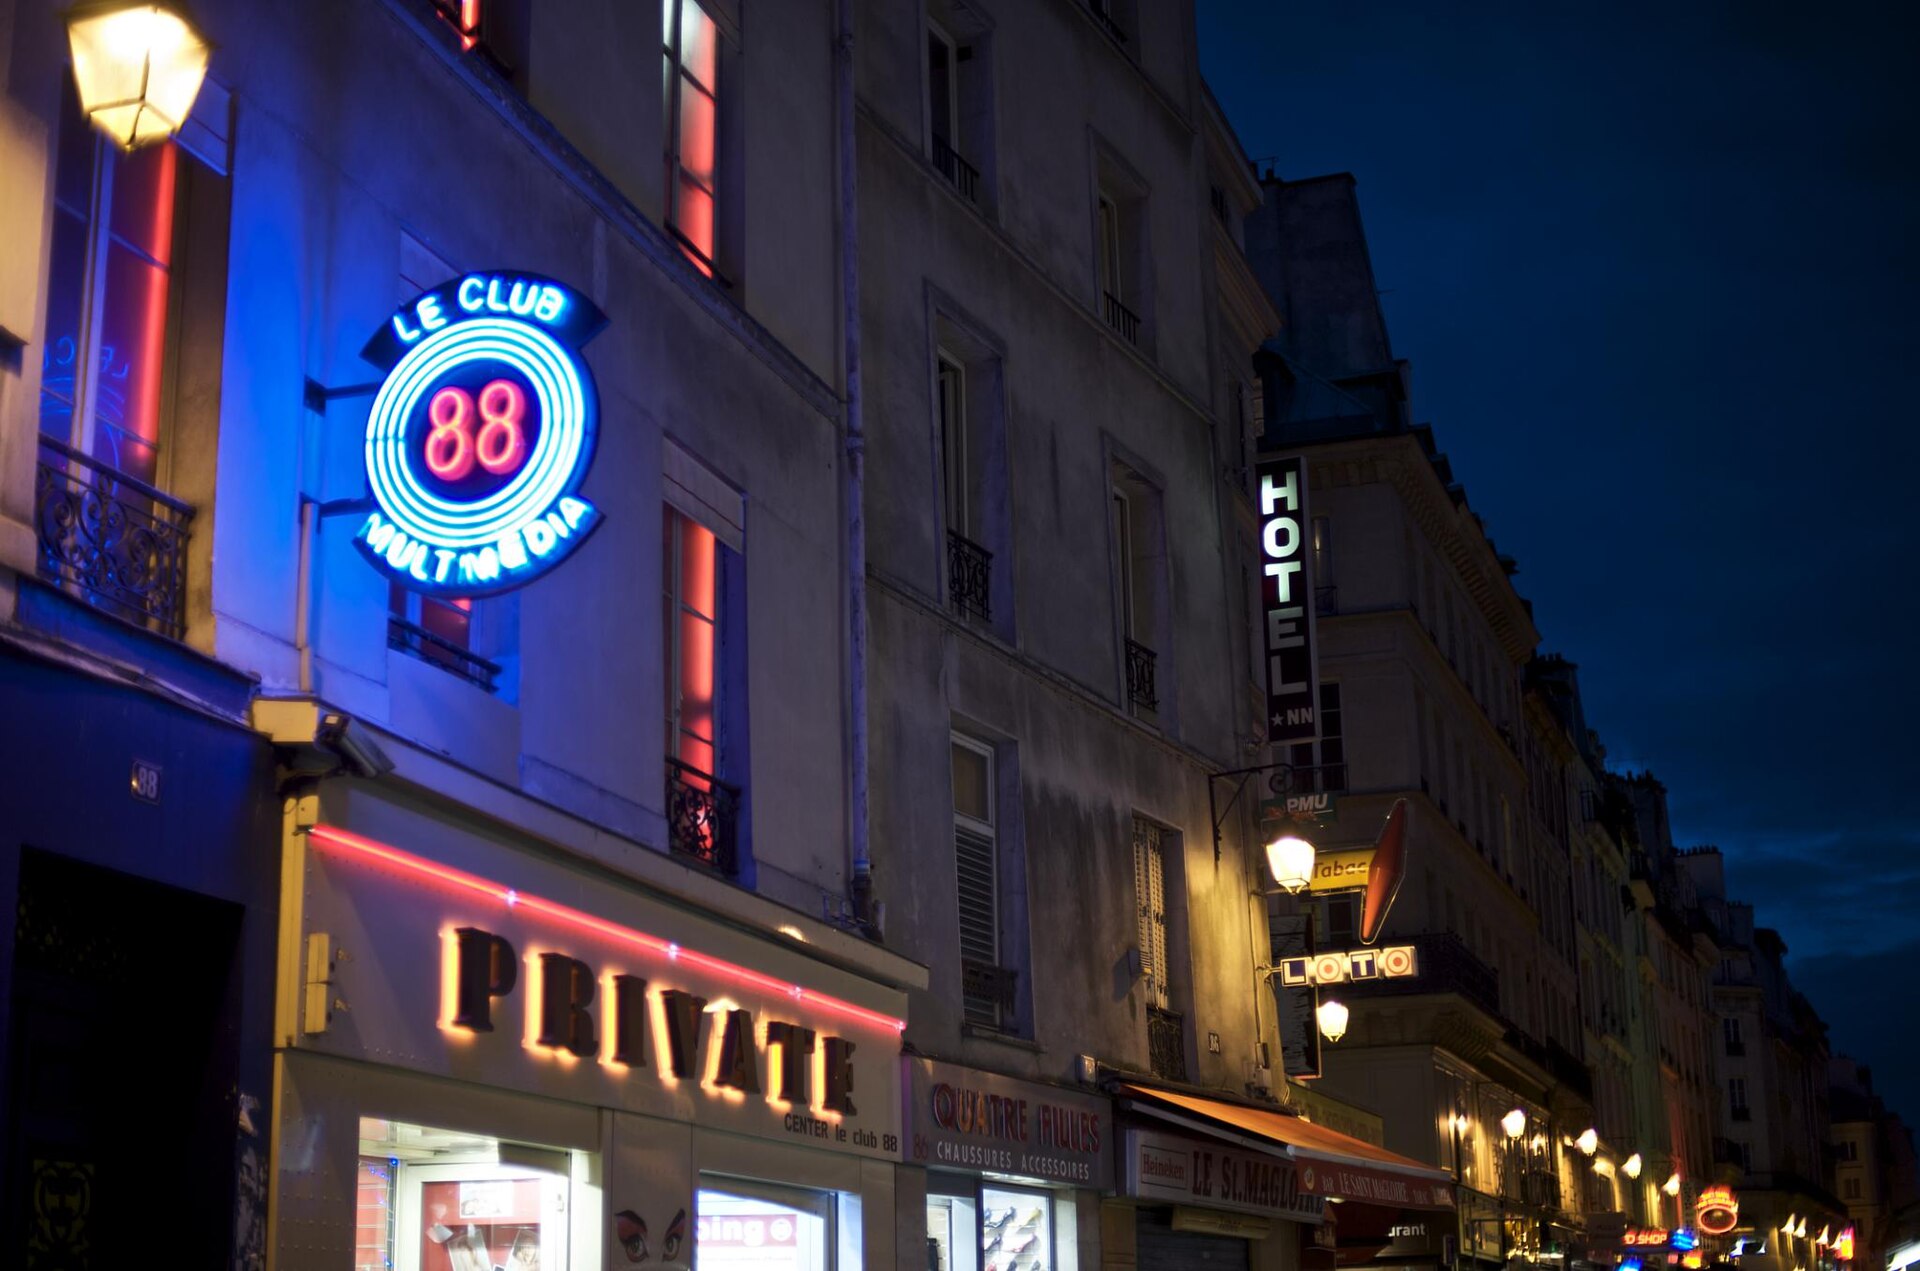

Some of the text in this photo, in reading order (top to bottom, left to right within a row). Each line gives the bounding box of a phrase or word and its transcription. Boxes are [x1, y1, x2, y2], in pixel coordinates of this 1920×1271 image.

[393, 277, 564, 341] LE CLUB
[425, 379, 525, 481] 88
[1261, 471, 1307, 696] HOTEL
[138, 767, 158, 799] 88
[1286, 793, 1328, 813] PMU
[1313, 860, 1367, 879] Tabac
[1282, 948, 1412, 985] LOTO
[440, 924, 857, 1117] PRIVATE
[784, 1113, 898, 1152] CENTER le club 88
[933, 1083, 1100, 1154] QUATRE FILLES
[937, 1141, 1089, 1180] CHAUSSURES ACCESSOIRES
[1143, 1154, 1185, 1180] Heineken
[1193, 1151, 1212, 1197] LE
[1339, 1171, 1352, 1195] LE
[1638, 1233, 1667, 1245] SHOP
